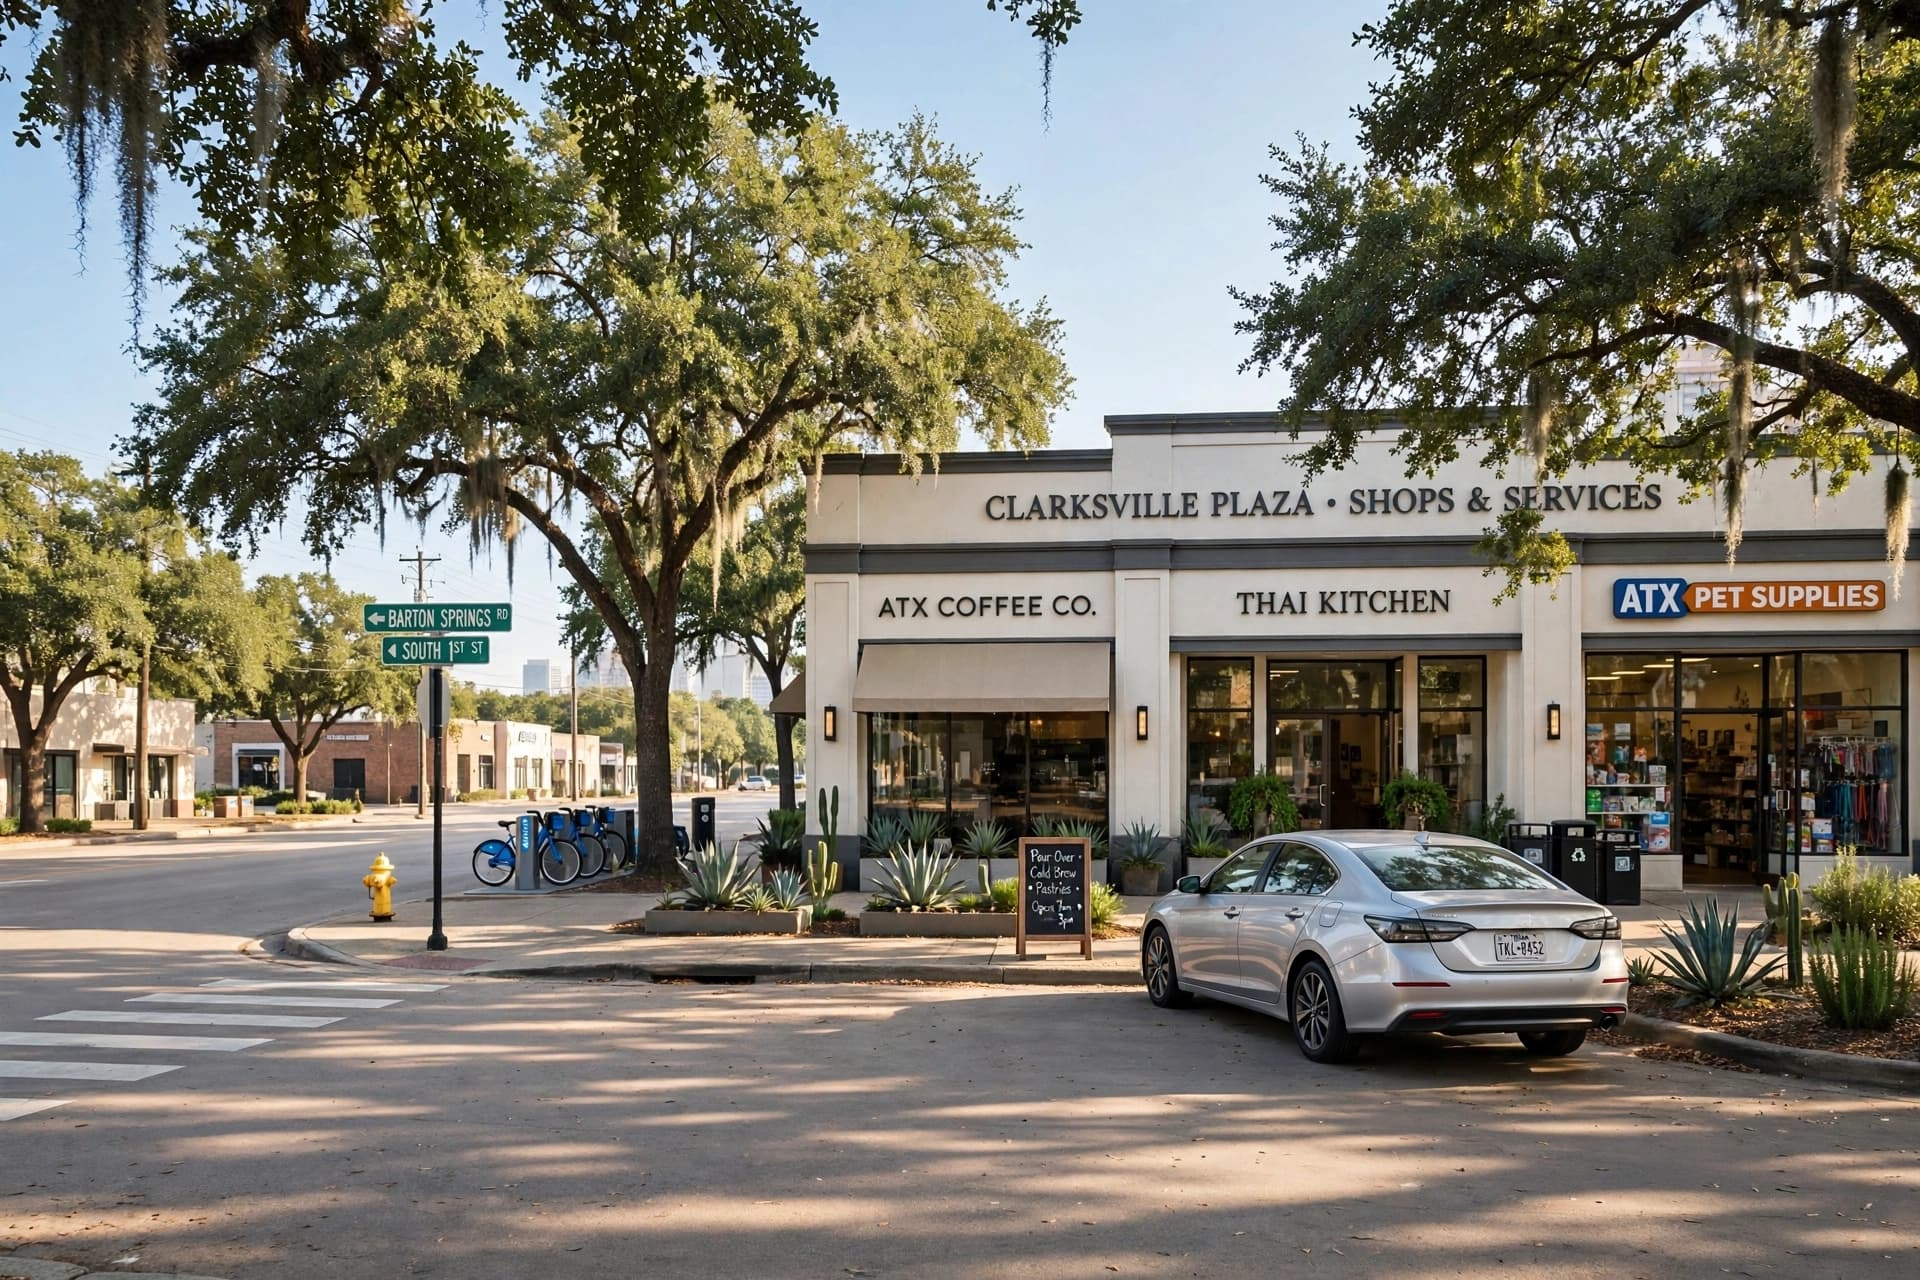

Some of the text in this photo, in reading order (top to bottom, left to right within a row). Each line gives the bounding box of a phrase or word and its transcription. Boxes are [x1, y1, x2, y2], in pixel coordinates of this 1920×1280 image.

[985, 483, 1662, 520] CLARKSVILLE PLAZA SHOPS & SERVICES
[878, 594, 1097, 618] ATX COFFEE CO.
[1236, 589, 1451, 615] THAI KITCHEN
[1619, 583, 1879, 613] ATX PET SUPPLIES
[388, 608, 508, 628] BARTON SPRINGS RD
[401, 640, 484, 662] SOUTH 1ST ST
[1030, 848, 1076, 863] Pour Over
[1030, 864, 1077, 879] Cold Brew
[1035, 881, 1072, 896] Pastries
